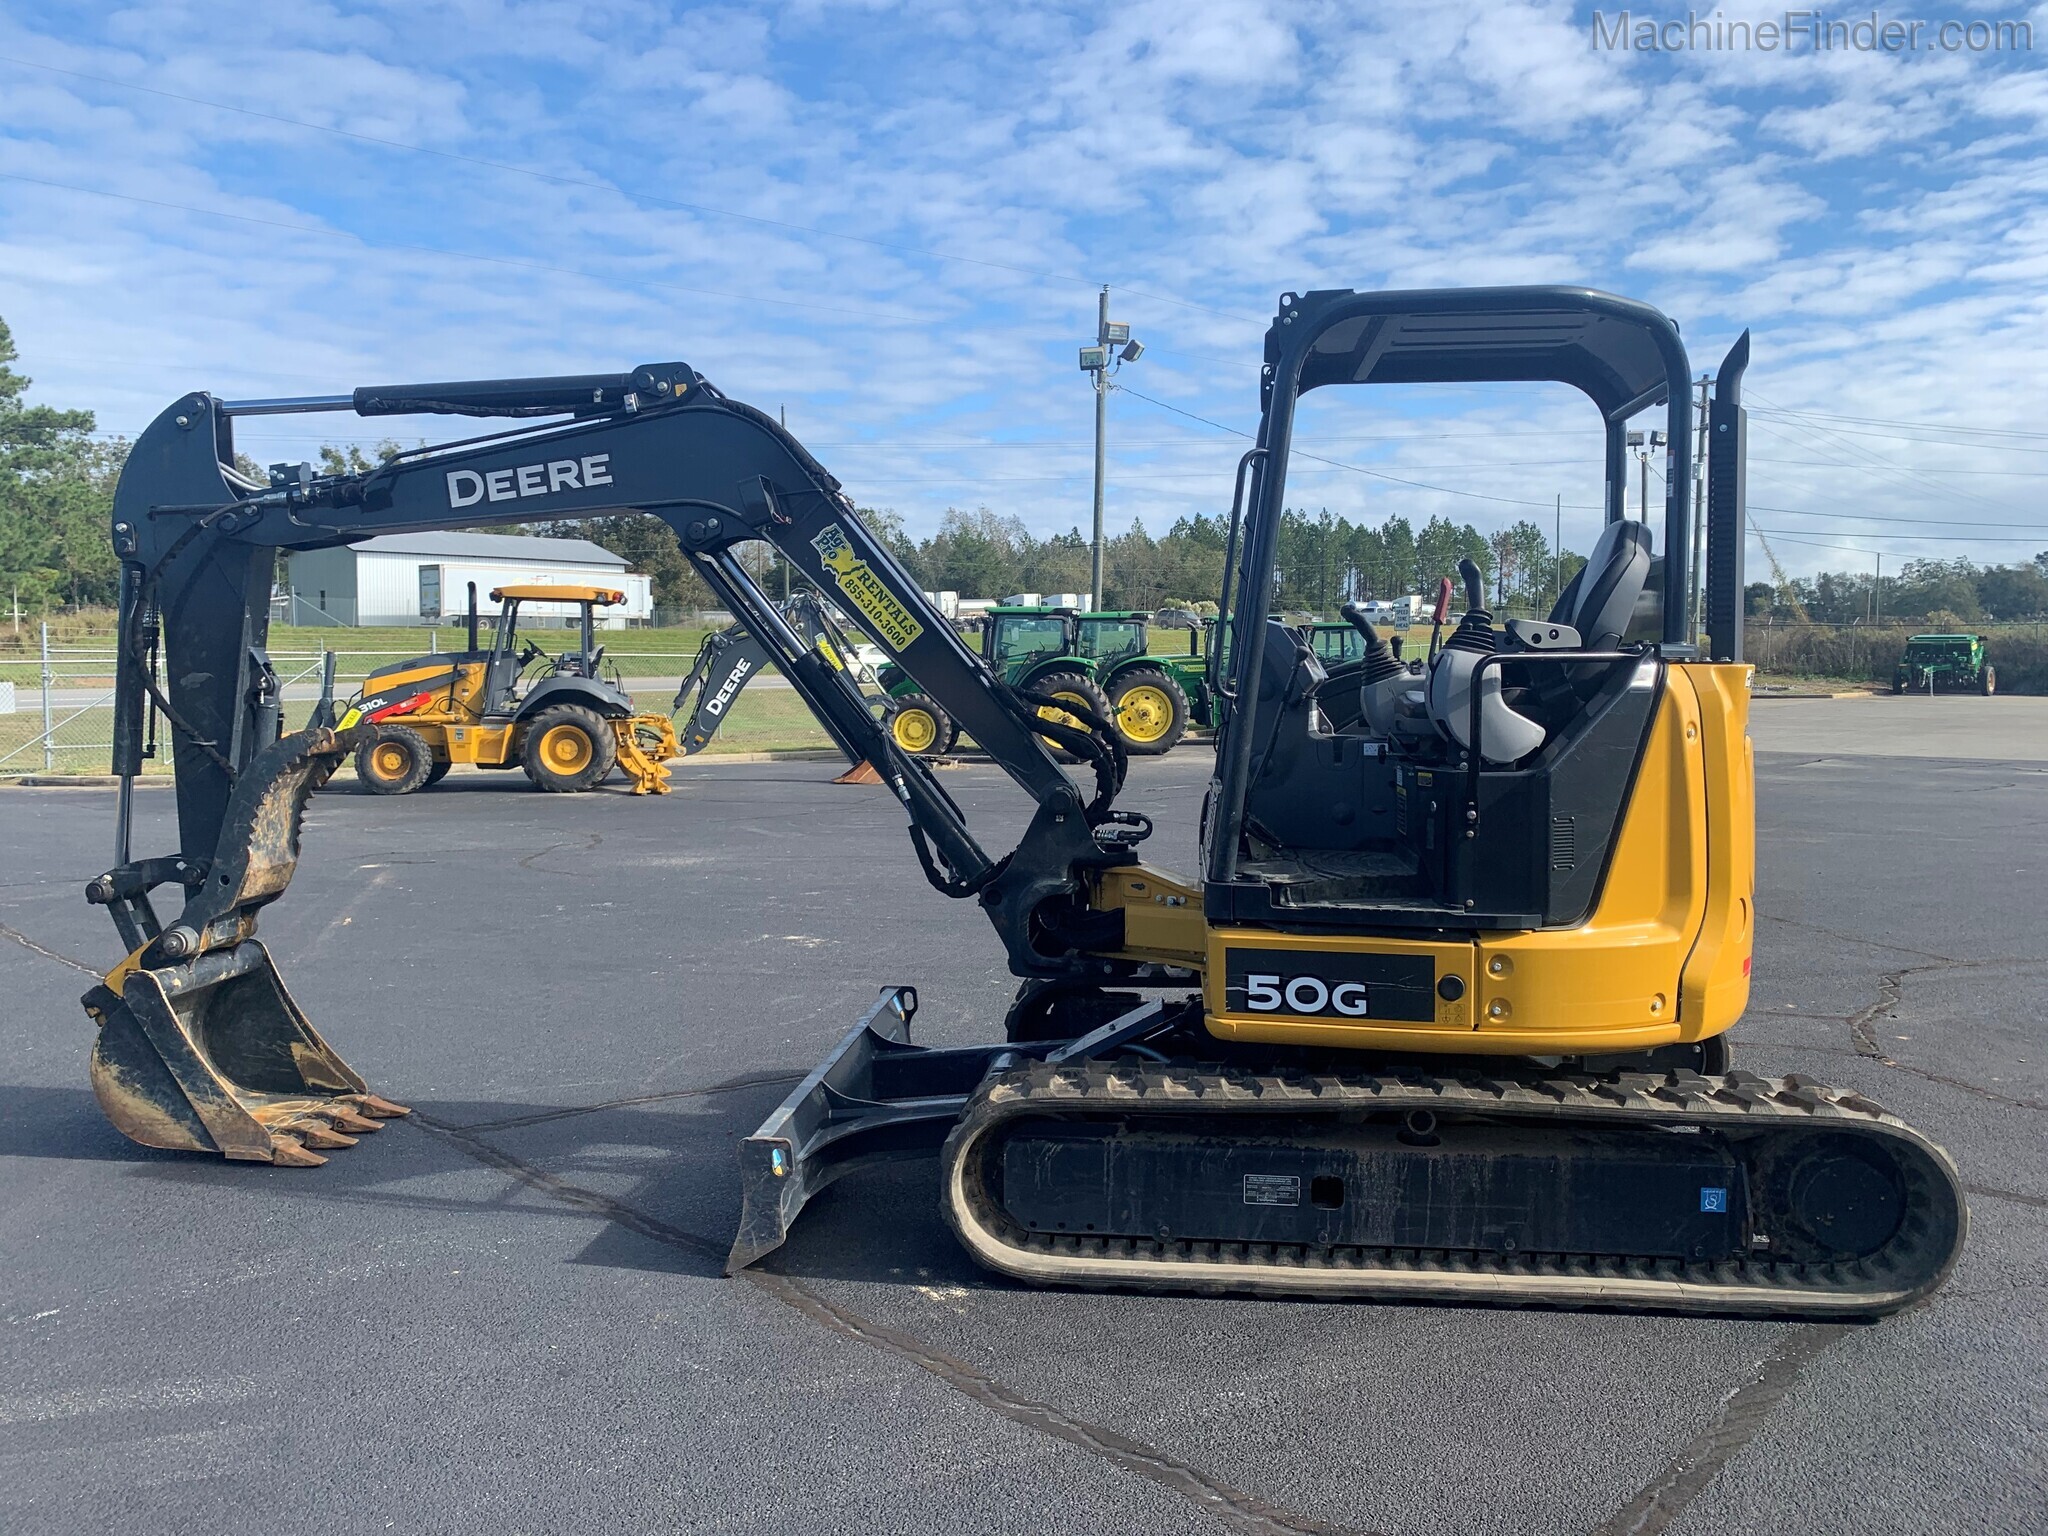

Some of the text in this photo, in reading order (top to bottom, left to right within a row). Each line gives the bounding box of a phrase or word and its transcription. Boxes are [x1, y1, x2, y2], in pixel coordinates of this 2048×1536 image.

[446, 453, 614, 508] DEERE
[815, 535, 838, 560] Pro
[825, 527, 847, 550] Ag-
[844, 579, 906, 646] 855-310-3600
[857, 570, 918, 636] RENTALS
[358, 698, 388, 713] 310L
[705, 657, 752, 716] DEERE
[1247, 974, 1367, 1016] 50G
